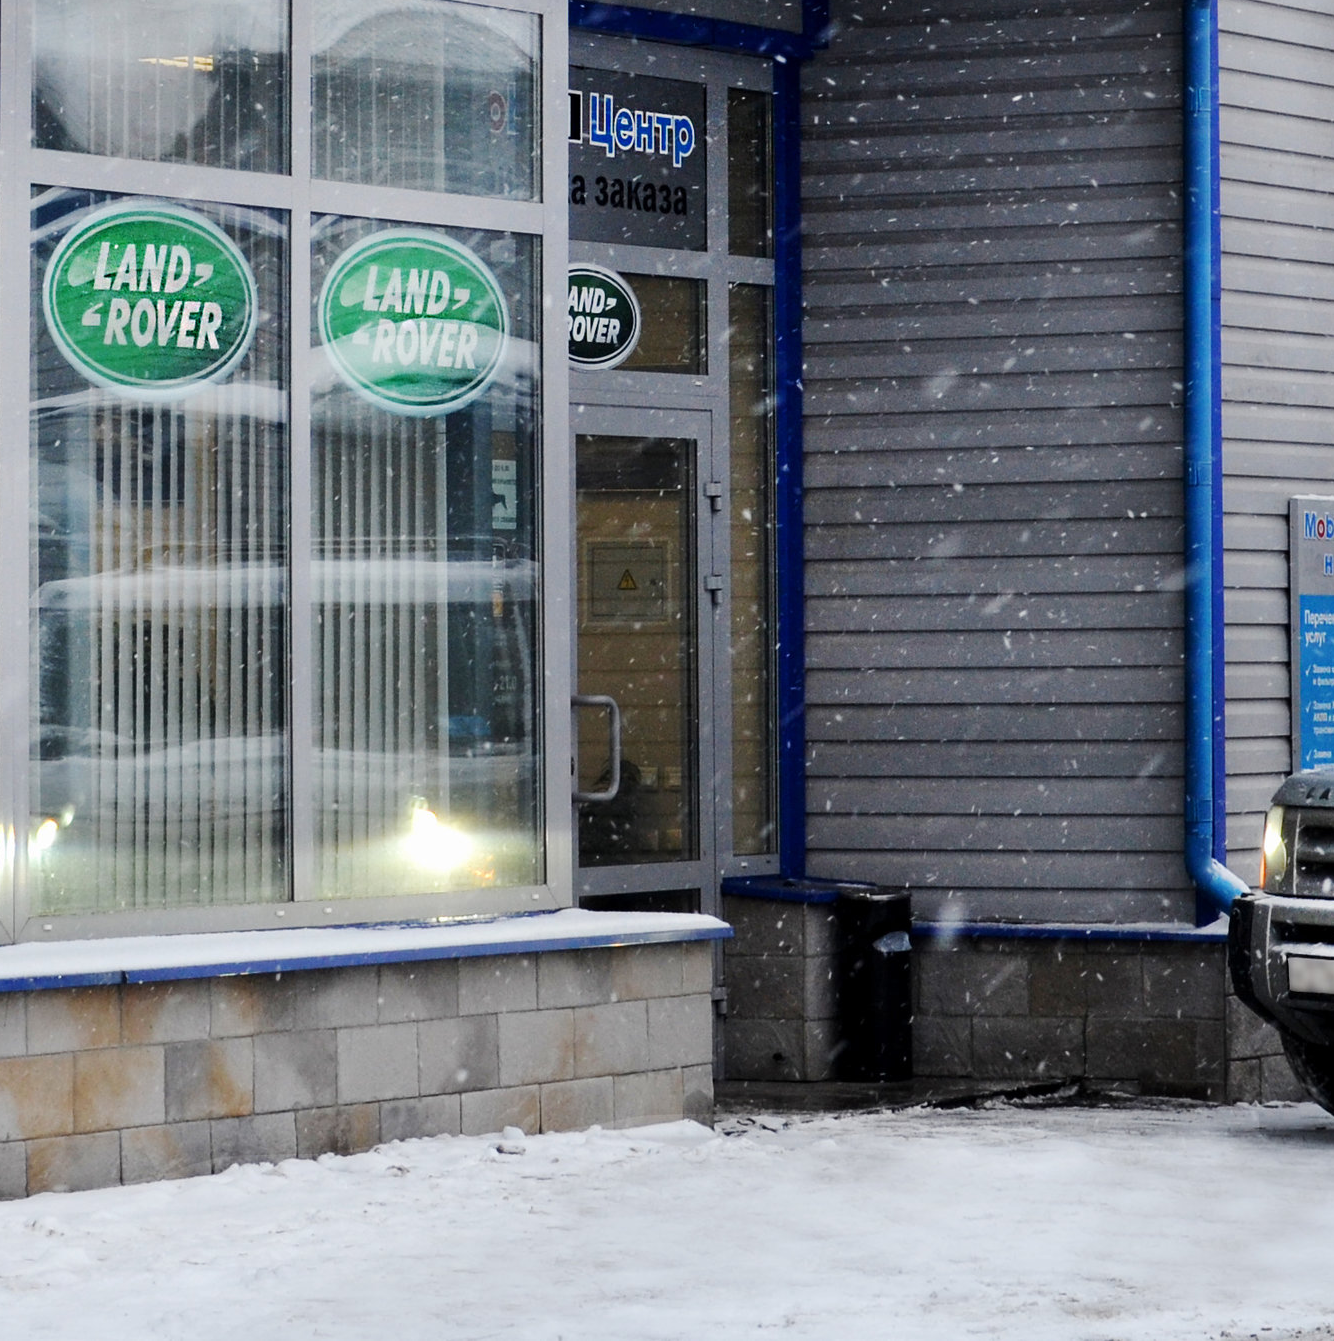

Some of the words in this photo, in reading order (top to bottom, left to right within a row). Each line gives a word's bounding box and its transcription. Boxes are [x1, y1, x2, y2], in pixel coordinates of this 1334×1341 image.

[589, 92, 695, 168] Центр
[594, 175, 687, 215] заказа
[93, 241, 192, 293] LAND
[363, 265, 454, 315] LAND
[104, 299, 223, 350] ROVER
[373, 319, 478, 370] ROVER
[1305, 631, 1327, 647] услуг
